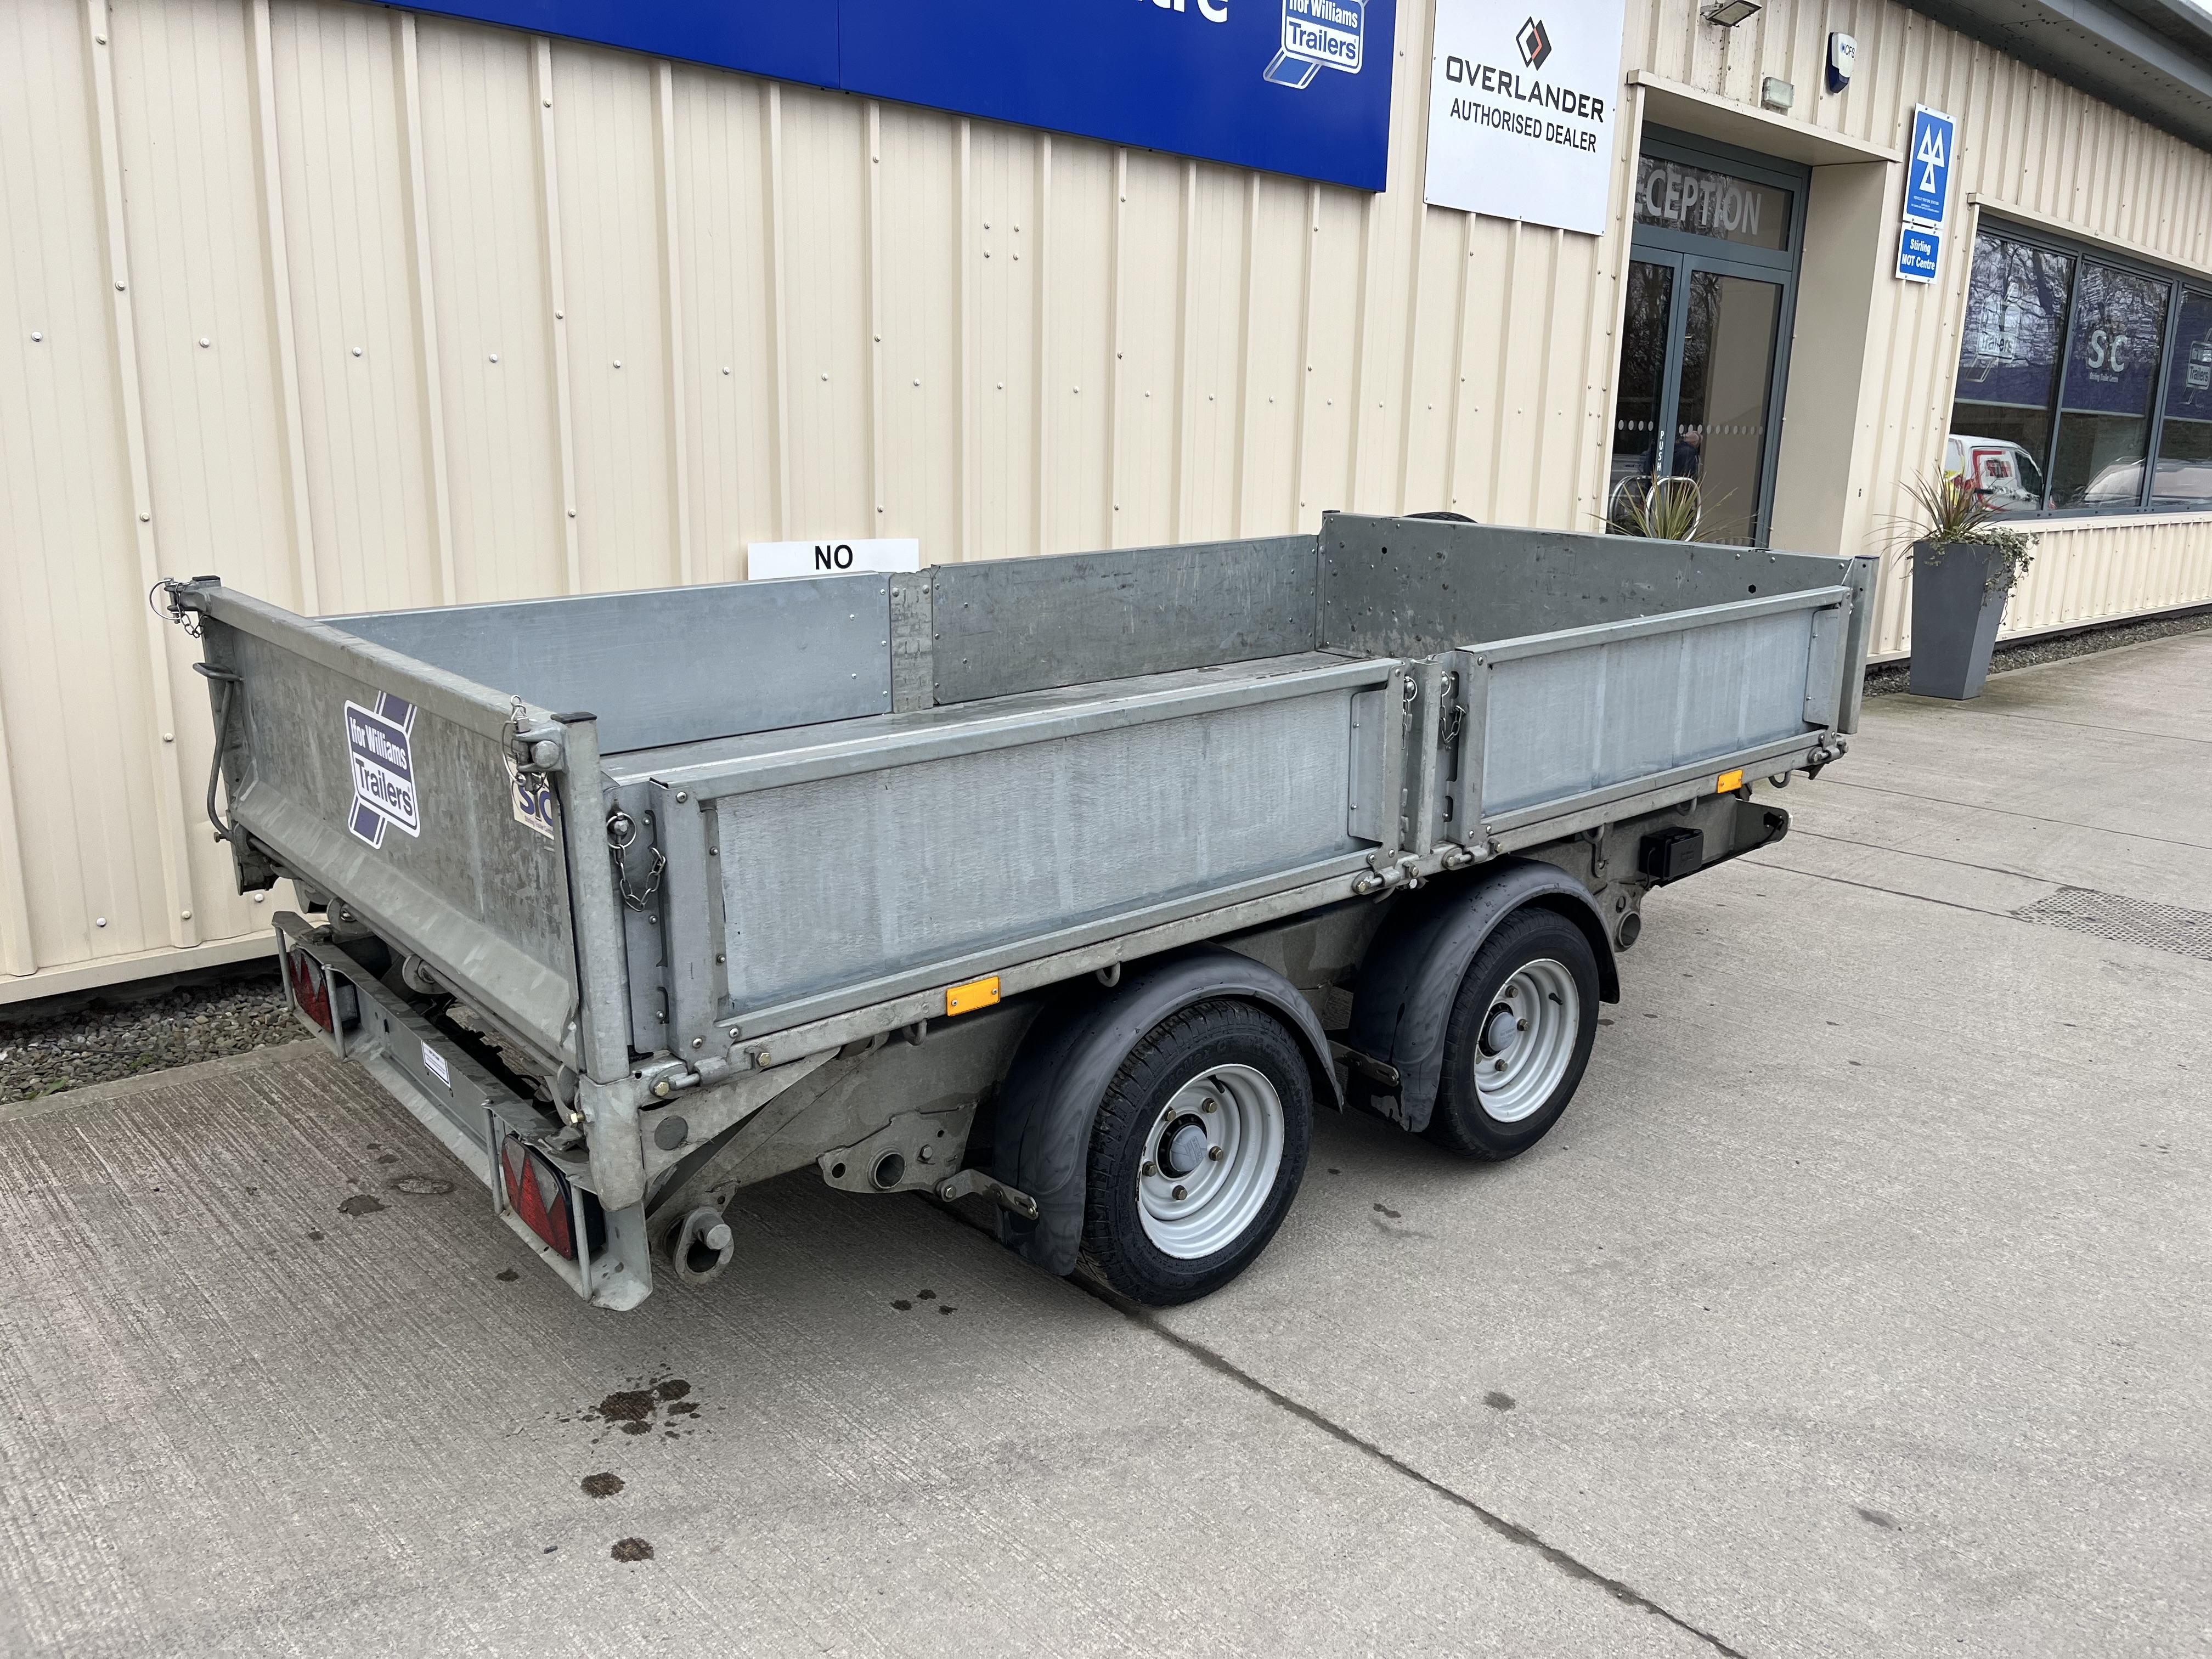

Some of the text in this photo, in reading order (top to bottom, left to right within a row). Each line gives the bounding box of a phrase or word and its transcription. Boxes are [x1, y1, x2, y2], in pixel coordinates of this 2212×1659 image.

[1311, 0, 1358, 29] Williams
[1289, 21, 1356, 60] Trailers
[1446, 55, 1604, 123] OVERLANDER
[1450, 98, 1596, 153] AUTHORISED DEALER
[1901, 253, 1936, 270] MOT Centre
[1910, 238, 1931, 256] Stirling
[815, 544, 853, 570] NO
[349, 716, 408, 770] Ifor Williams
[355, 757, 413, 816] Trailers
